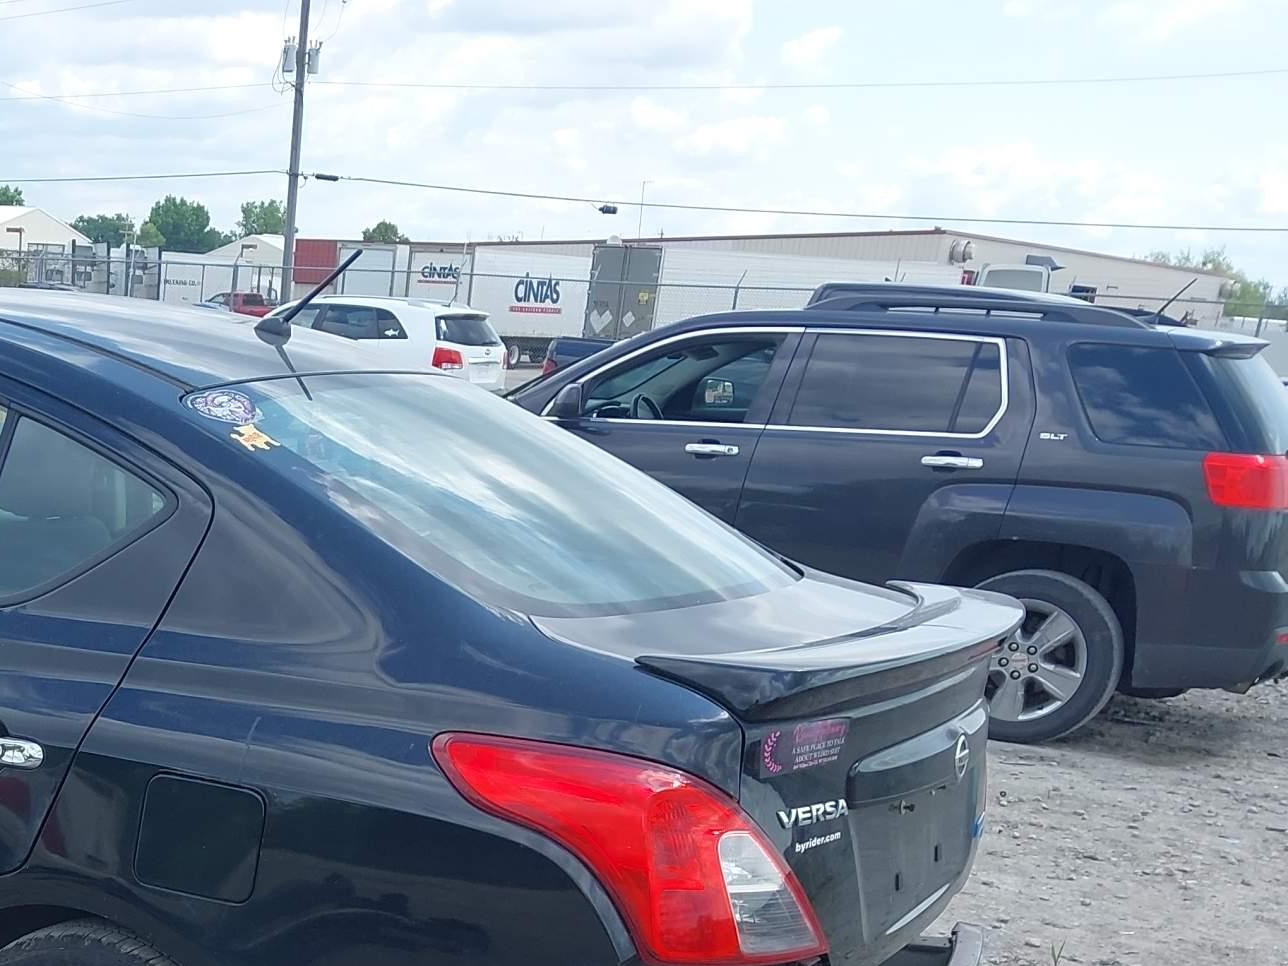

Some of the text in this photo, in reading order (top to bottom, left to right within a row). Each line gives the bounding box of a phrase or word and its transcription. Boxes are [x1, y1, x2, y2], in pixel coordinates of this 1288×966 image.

[421, 262, 460, 279] CINTAS
[514, 272, 560, 304] CINTAS
[1039, 432, 1068, 440] SLT
[776, 798, 848, 829] VERSA
[795, 831, 841, 853] byrider.com
